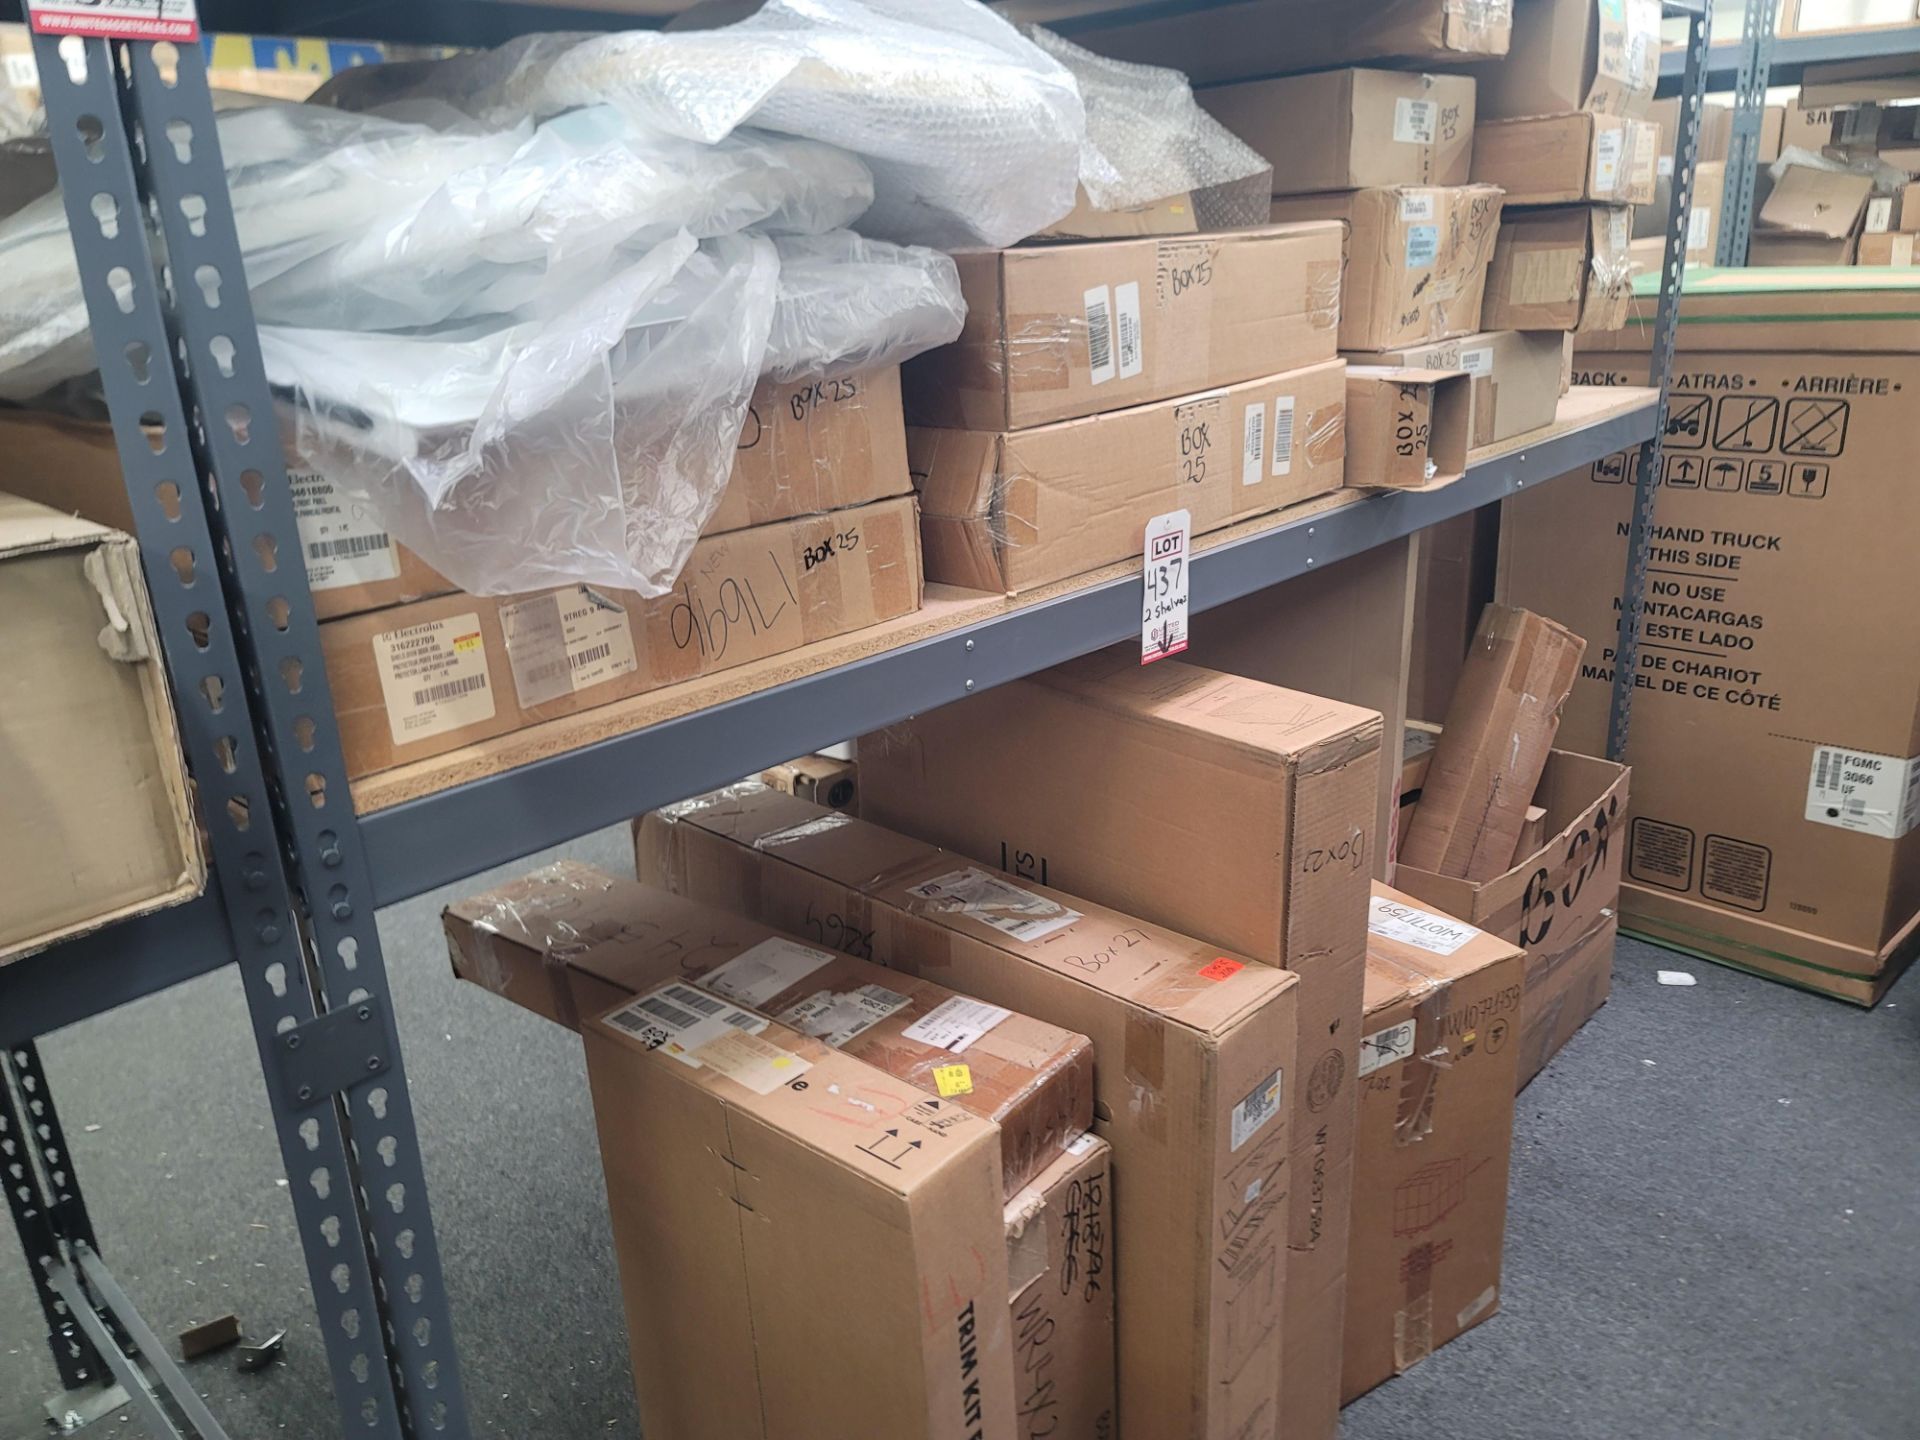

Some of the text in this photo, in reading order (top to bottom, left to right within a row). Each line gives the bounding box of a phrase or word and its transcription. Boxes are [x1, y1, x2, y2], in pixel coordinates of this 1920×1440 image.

[1442, 105, 1459, 126] BOX
[1806, 111, 1834, 126] SA
[1172, 264, 1196, 296] BOX
[1426, 349, 1458, 369] BOX 25
[829, 378, 856, 402] 25
[1677, 374, 1744, 390] ATRAS
[1794, 373, 1889, 395] ARRIÈRE
[1181, 422, 1211, 456] BOX
[1396, 411, 1414, 456] BOX
[1416, 424, 1428, 449] 25
[1183, 455, 1206, 483] 25
[803, 528, 859, 570] BOX 25
[1155, 536, 1180, 556] LOT
[1650, 525, 1705, 543] HAND
[1711, 531, 1782, 551] TRUCK
[1647, 546, 1742, 570] THIS SIDE
[1148, 557, 1183, 602] 437
[1652, 581, 1727, 602] NO USE
[1144, 609, 1152, 623] 2
[1646, 623, 1694, 642] ESTE
[1699, 631, 1755, 650] LADO
[1641, 654, 1667, 671] DE
[1672, 659, 1762, 684] CHARIOT
[1662, 679, 1687, 695] DE
[1693, 685, 1720, 701] CE
[1725, 690, 1782, 711] CÔTÉ
[1844, 755, 1883, 771] FGMC
[1843, 771, 1875, 786] 3066
[1326, 830, 1365, 871] Box
[1064, 928, 1153, 974] Box 27
[957, 1300, 978, 1379] TRIM
[963, 1378, 983, 1428] KIT
